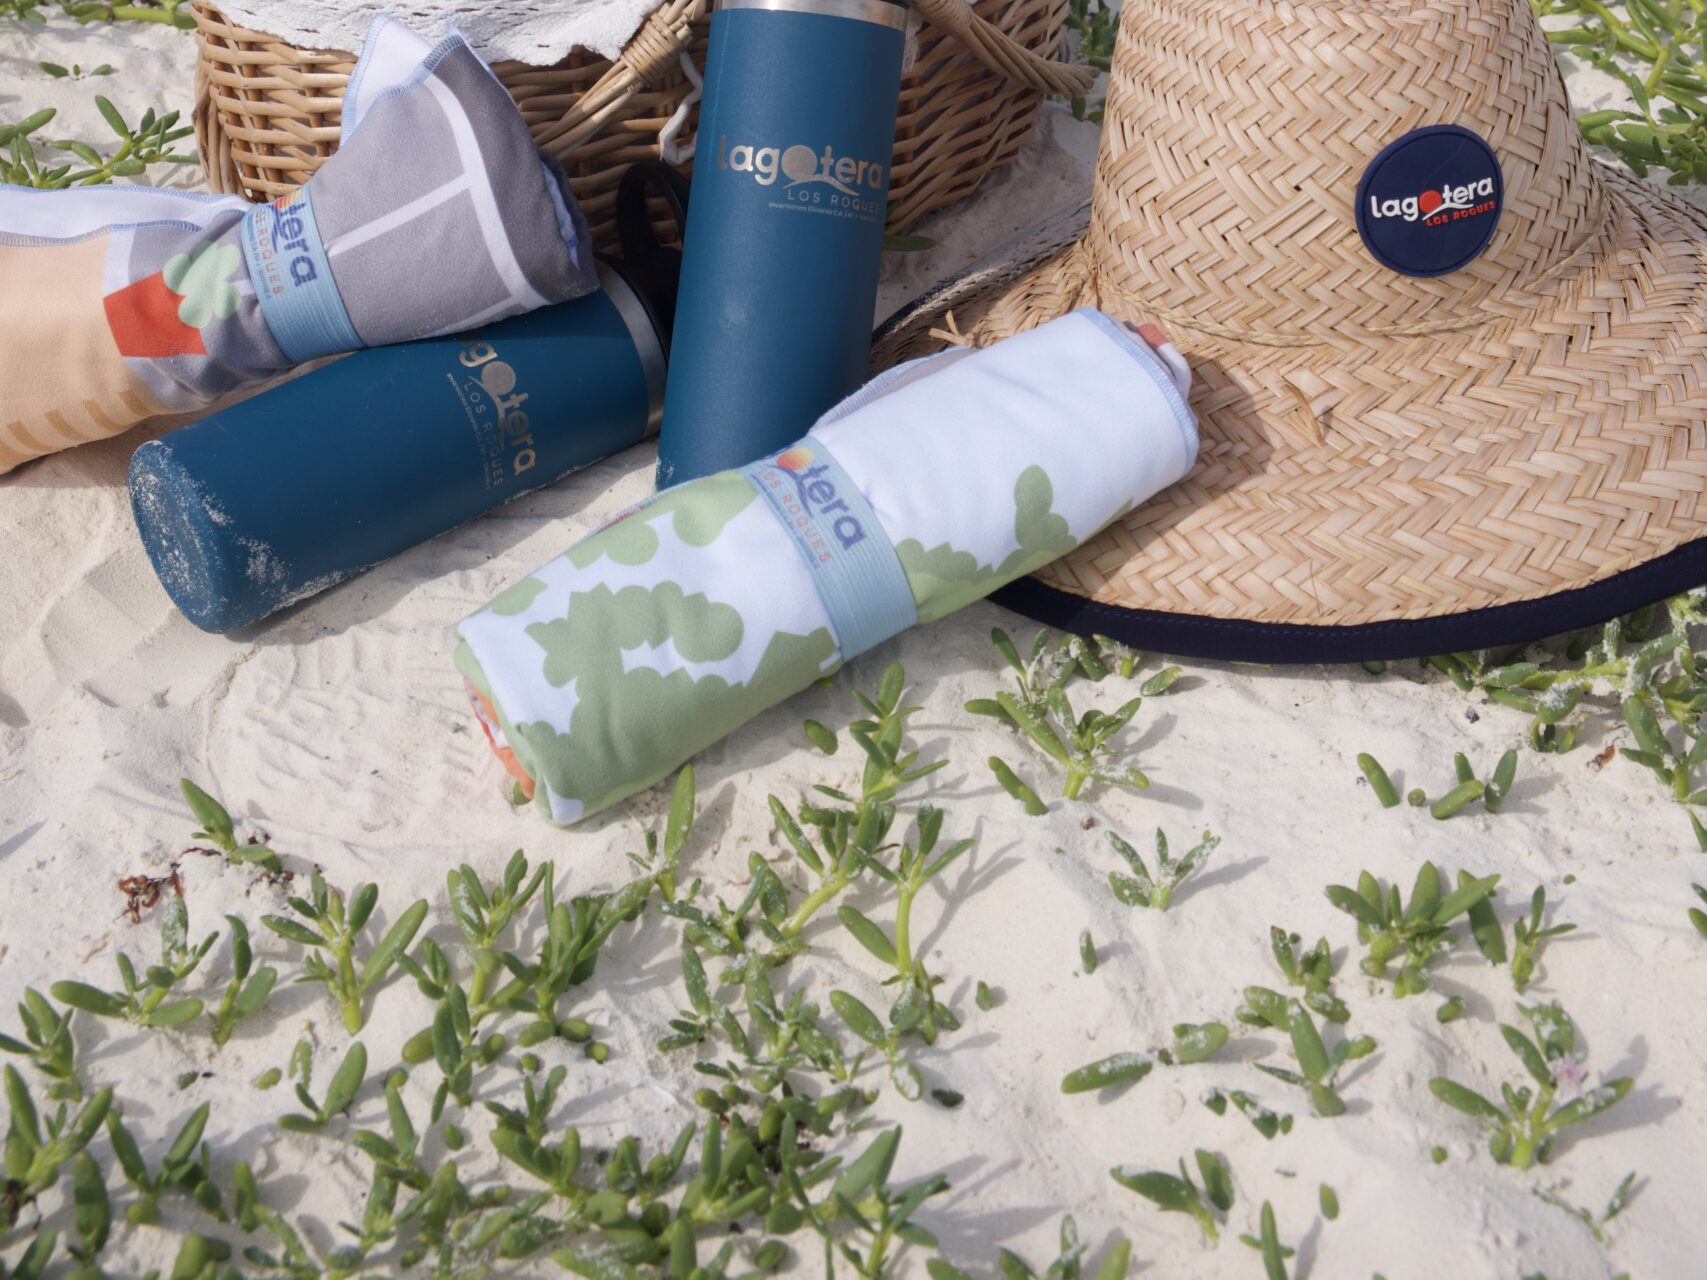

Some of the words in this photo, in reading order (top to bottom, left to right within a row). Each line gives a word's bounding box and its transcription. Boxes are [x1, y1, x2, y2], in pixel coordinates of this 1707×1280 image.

[787, 189, 821, 205] LOS
[1371, 176, 1494, 222] lagotera
[1425, 215, 1450, 228] LOS
[1453, 201, 1497, 221] ROQUES
[279, 202, 318, 288] tera
[463, 381, 487, 415] LOS
[481, 422, 504, 487] ROQUES
[780, 493, 833, 563] ROQUES
